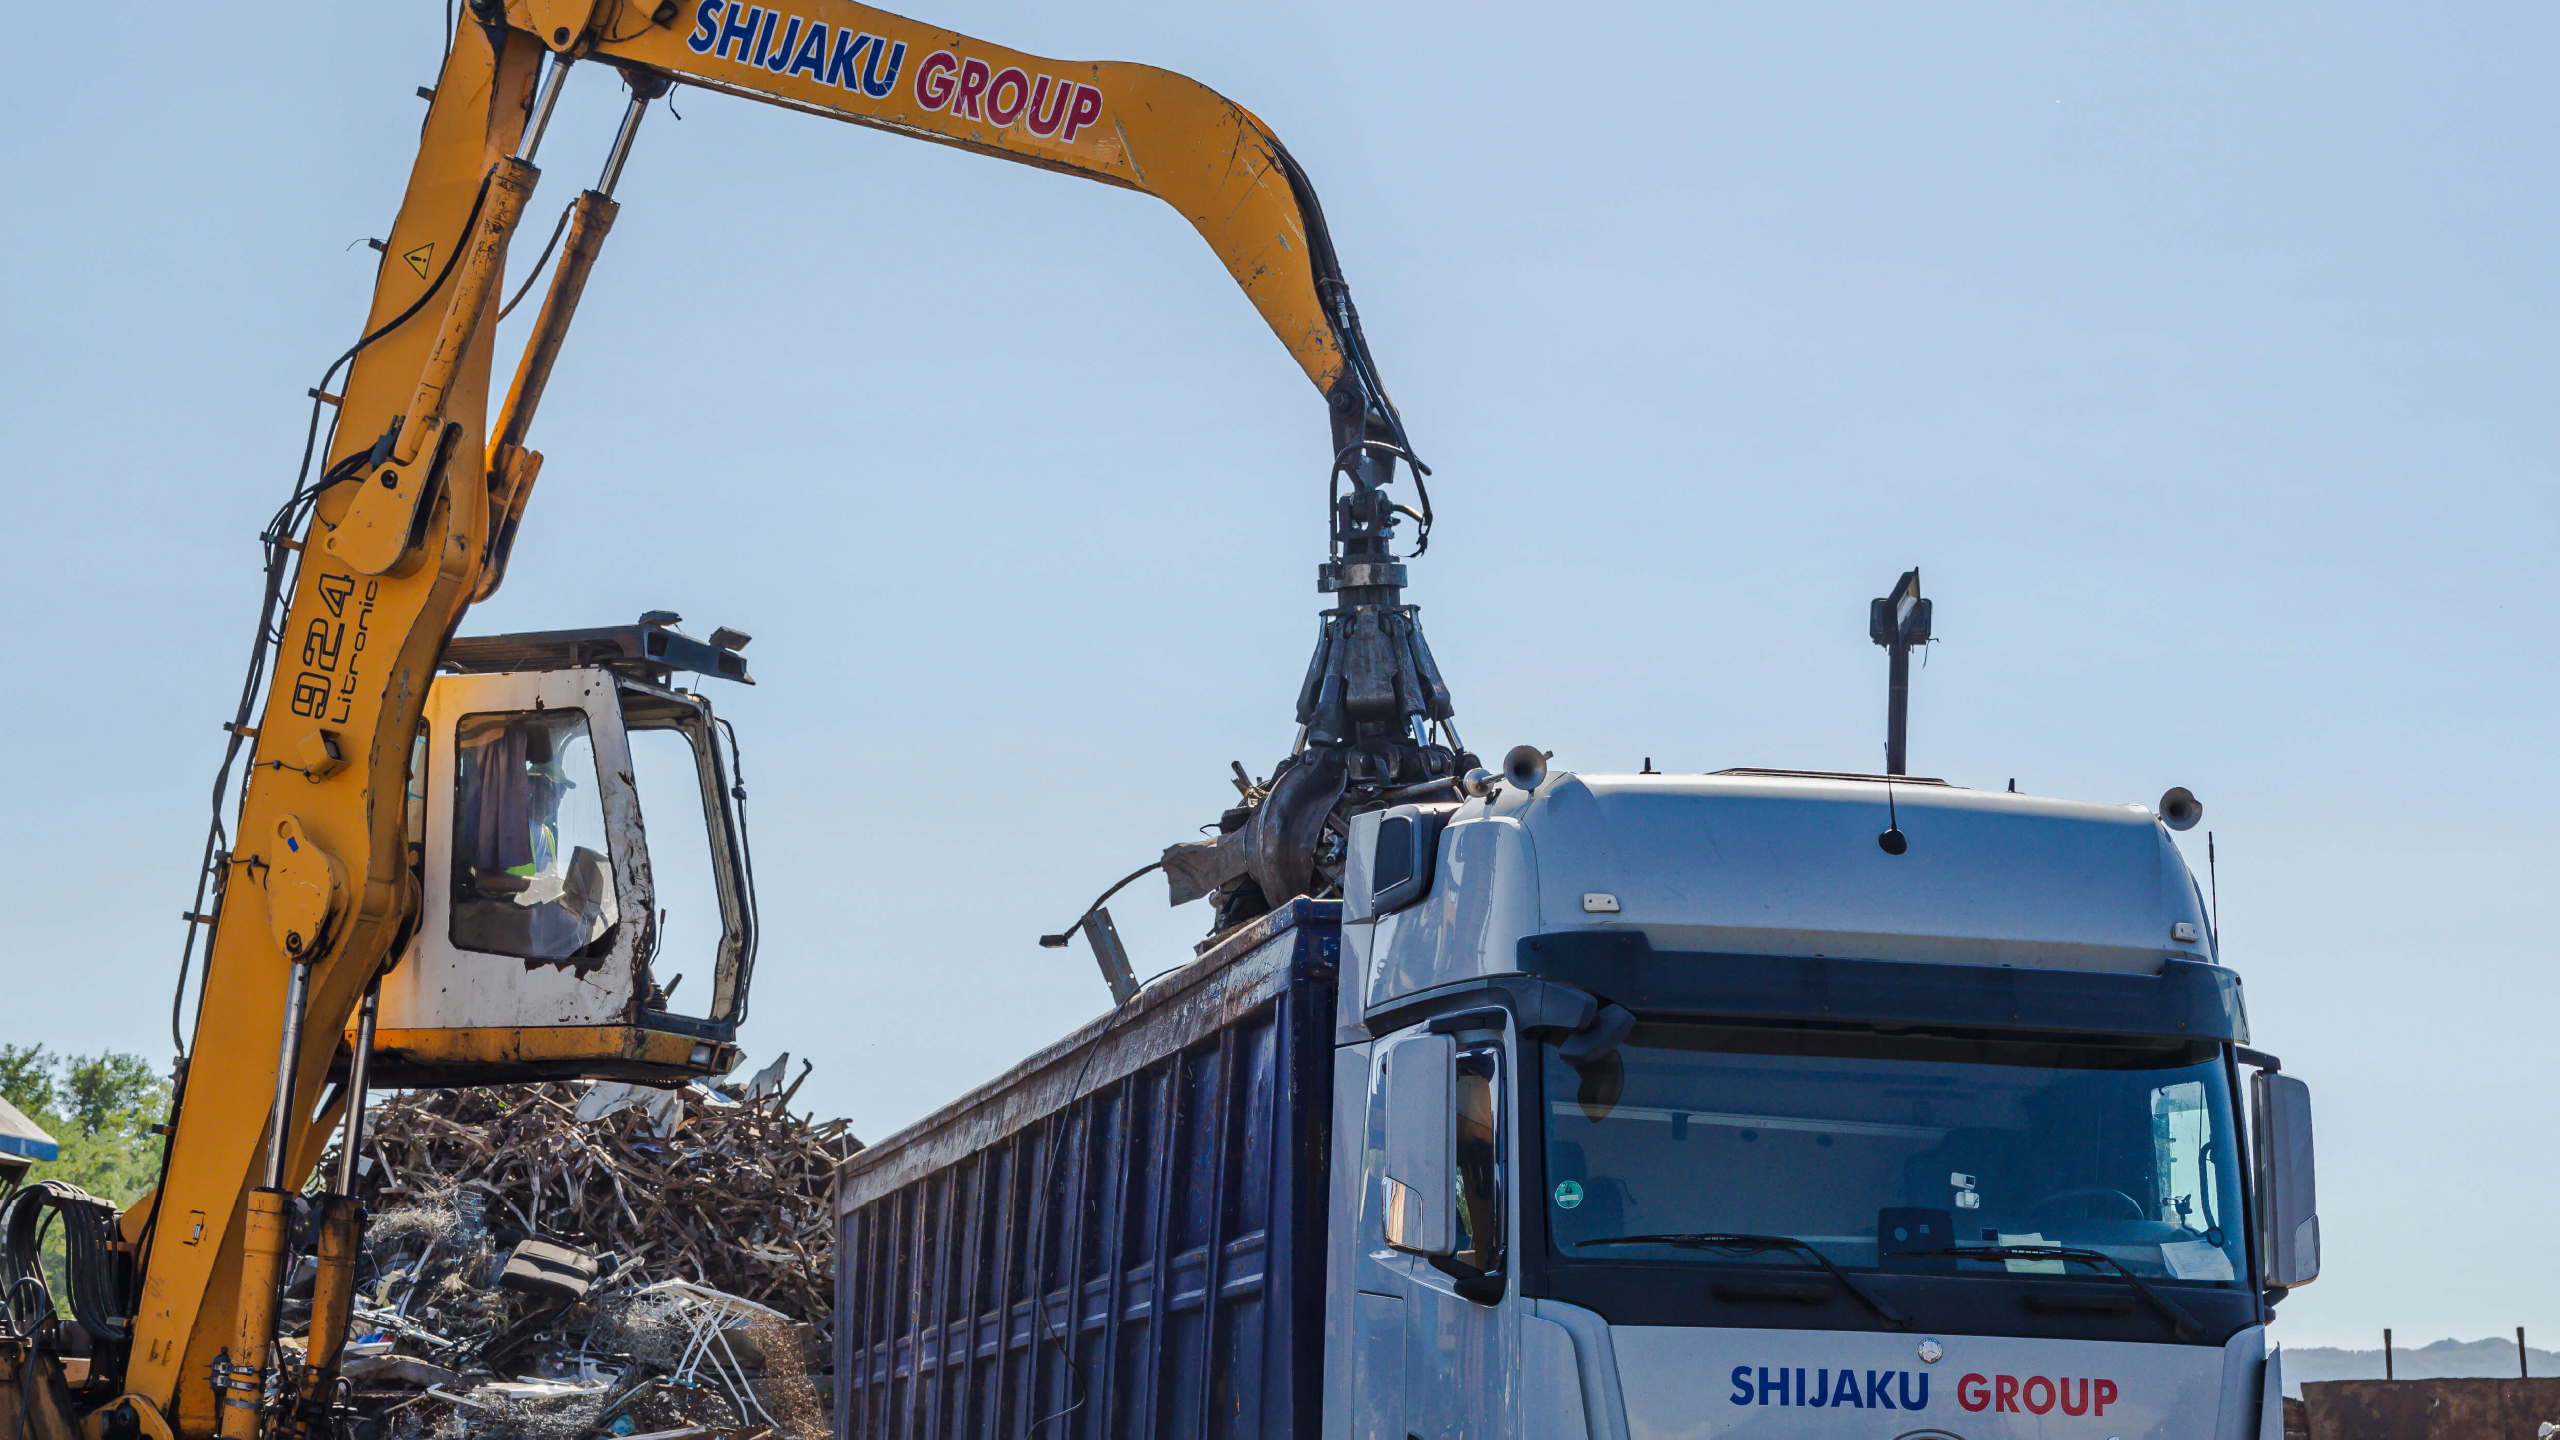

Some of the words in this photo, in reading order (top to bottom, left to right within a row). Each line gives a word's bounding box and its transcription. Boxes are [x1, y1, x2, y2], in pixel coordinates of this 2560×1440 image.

[687, 0, 908, 99] SHIJAKU
[914, 50, 1103, 144] GROUP
[291, 573, 356, 719] 924
[331, 580, 379, 724] Litronic
[1729, 1365, 1929, 1410] SHIJAKU
[1956, 1372, 2118, 1417] GROUP
